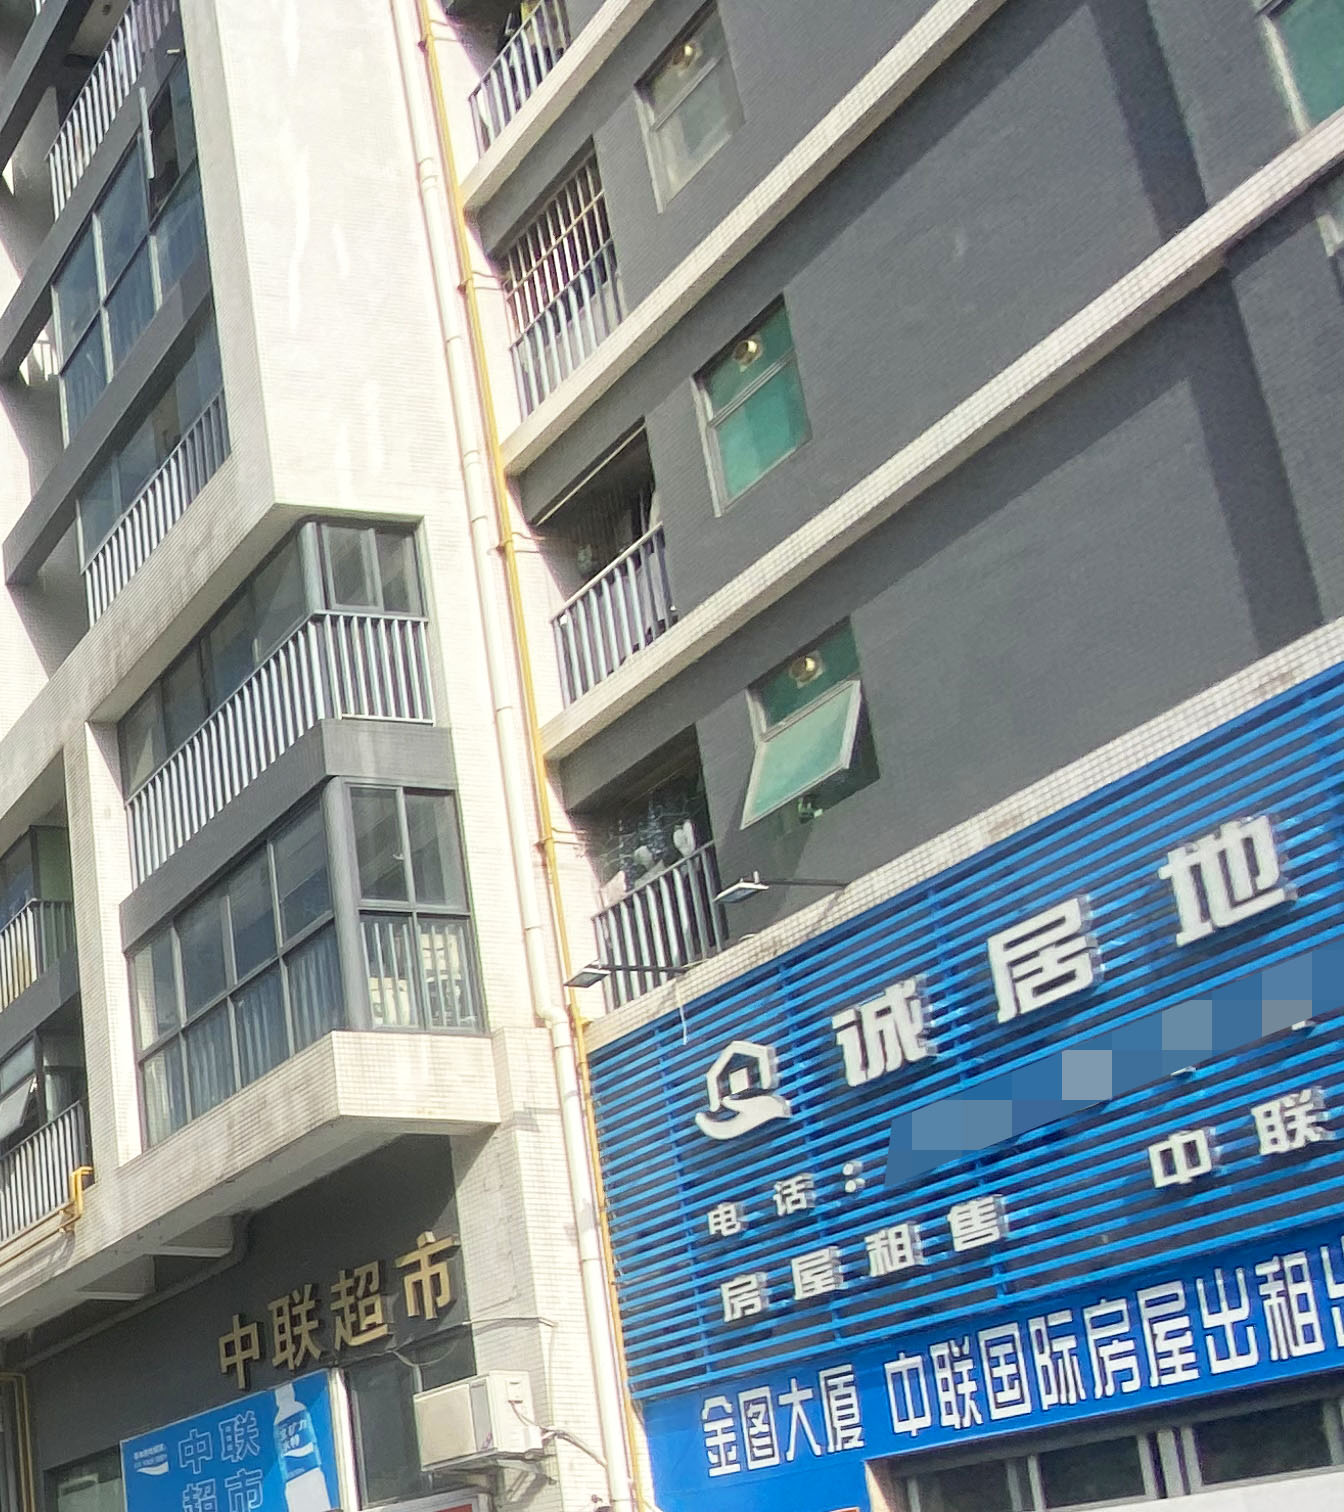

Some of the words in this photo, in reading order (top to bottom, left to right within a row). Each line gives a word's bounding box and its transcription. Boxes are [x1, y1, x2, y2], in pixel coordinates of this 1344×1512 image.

[830, 813, 1294, 1088] 诚居地
[719, 1194, 1007, 1325] 房屋租售
[1147, 1088, 1326, 1189] 中联
[217, 1231, 459, 1391] 中联超市
[178, 1410, 260, 1475] 中联
[701, 1363, 865, 1479] 金图大厦
